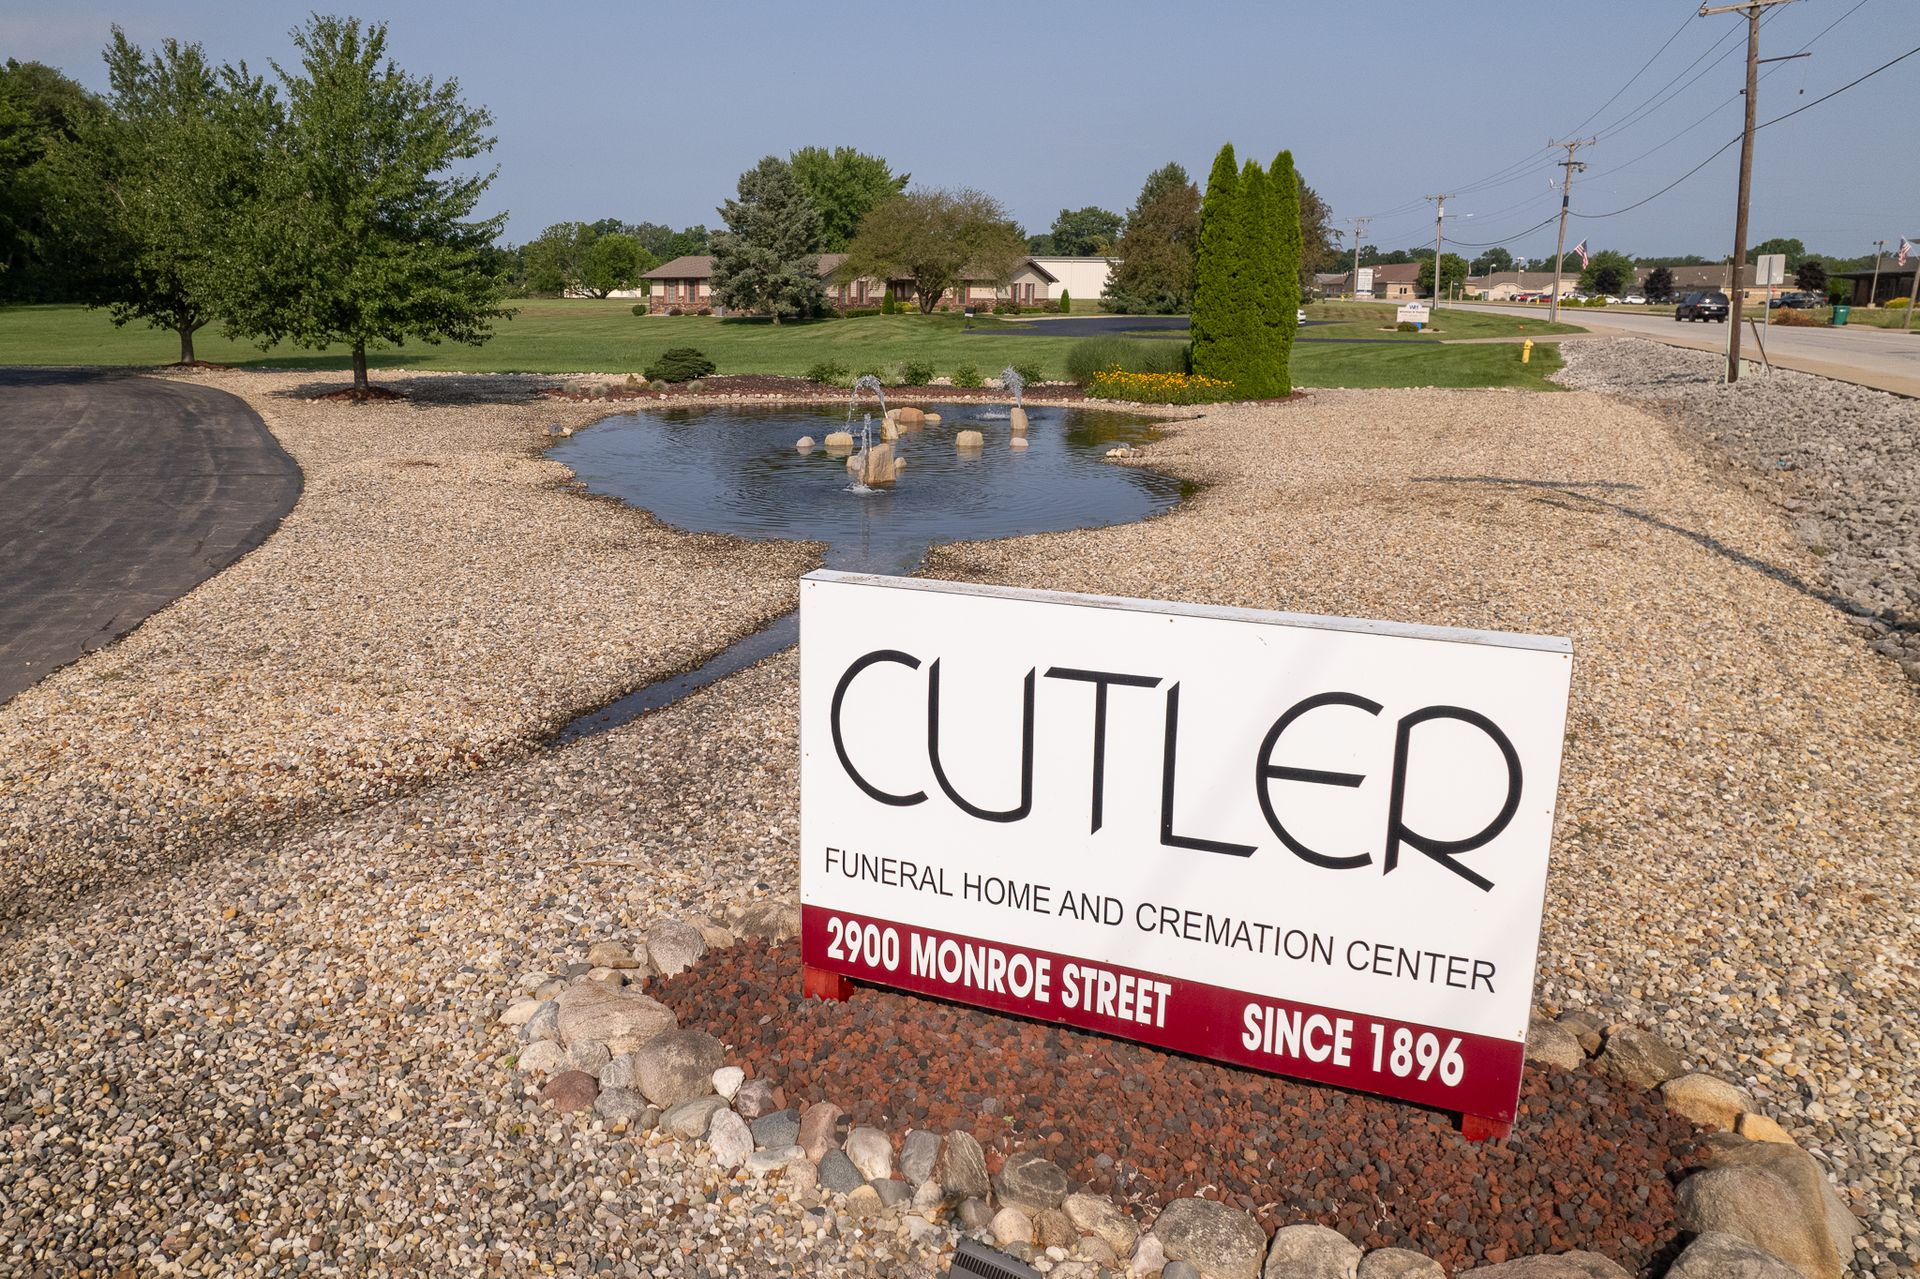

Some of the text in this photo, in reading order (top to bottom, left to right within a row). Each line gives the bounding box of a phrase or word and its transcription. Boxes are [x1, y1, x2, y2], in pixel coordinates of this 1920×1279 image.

[830, 649, 1523, 893] CUTLER
[825, 847, 1496, 994] FUNERAL HOME AND CREMATION CENTER
[827, 916, 1172, 1028] 2900 MONROE STREET
[1241, 1002, 1465, 1087] SINCE 1896
